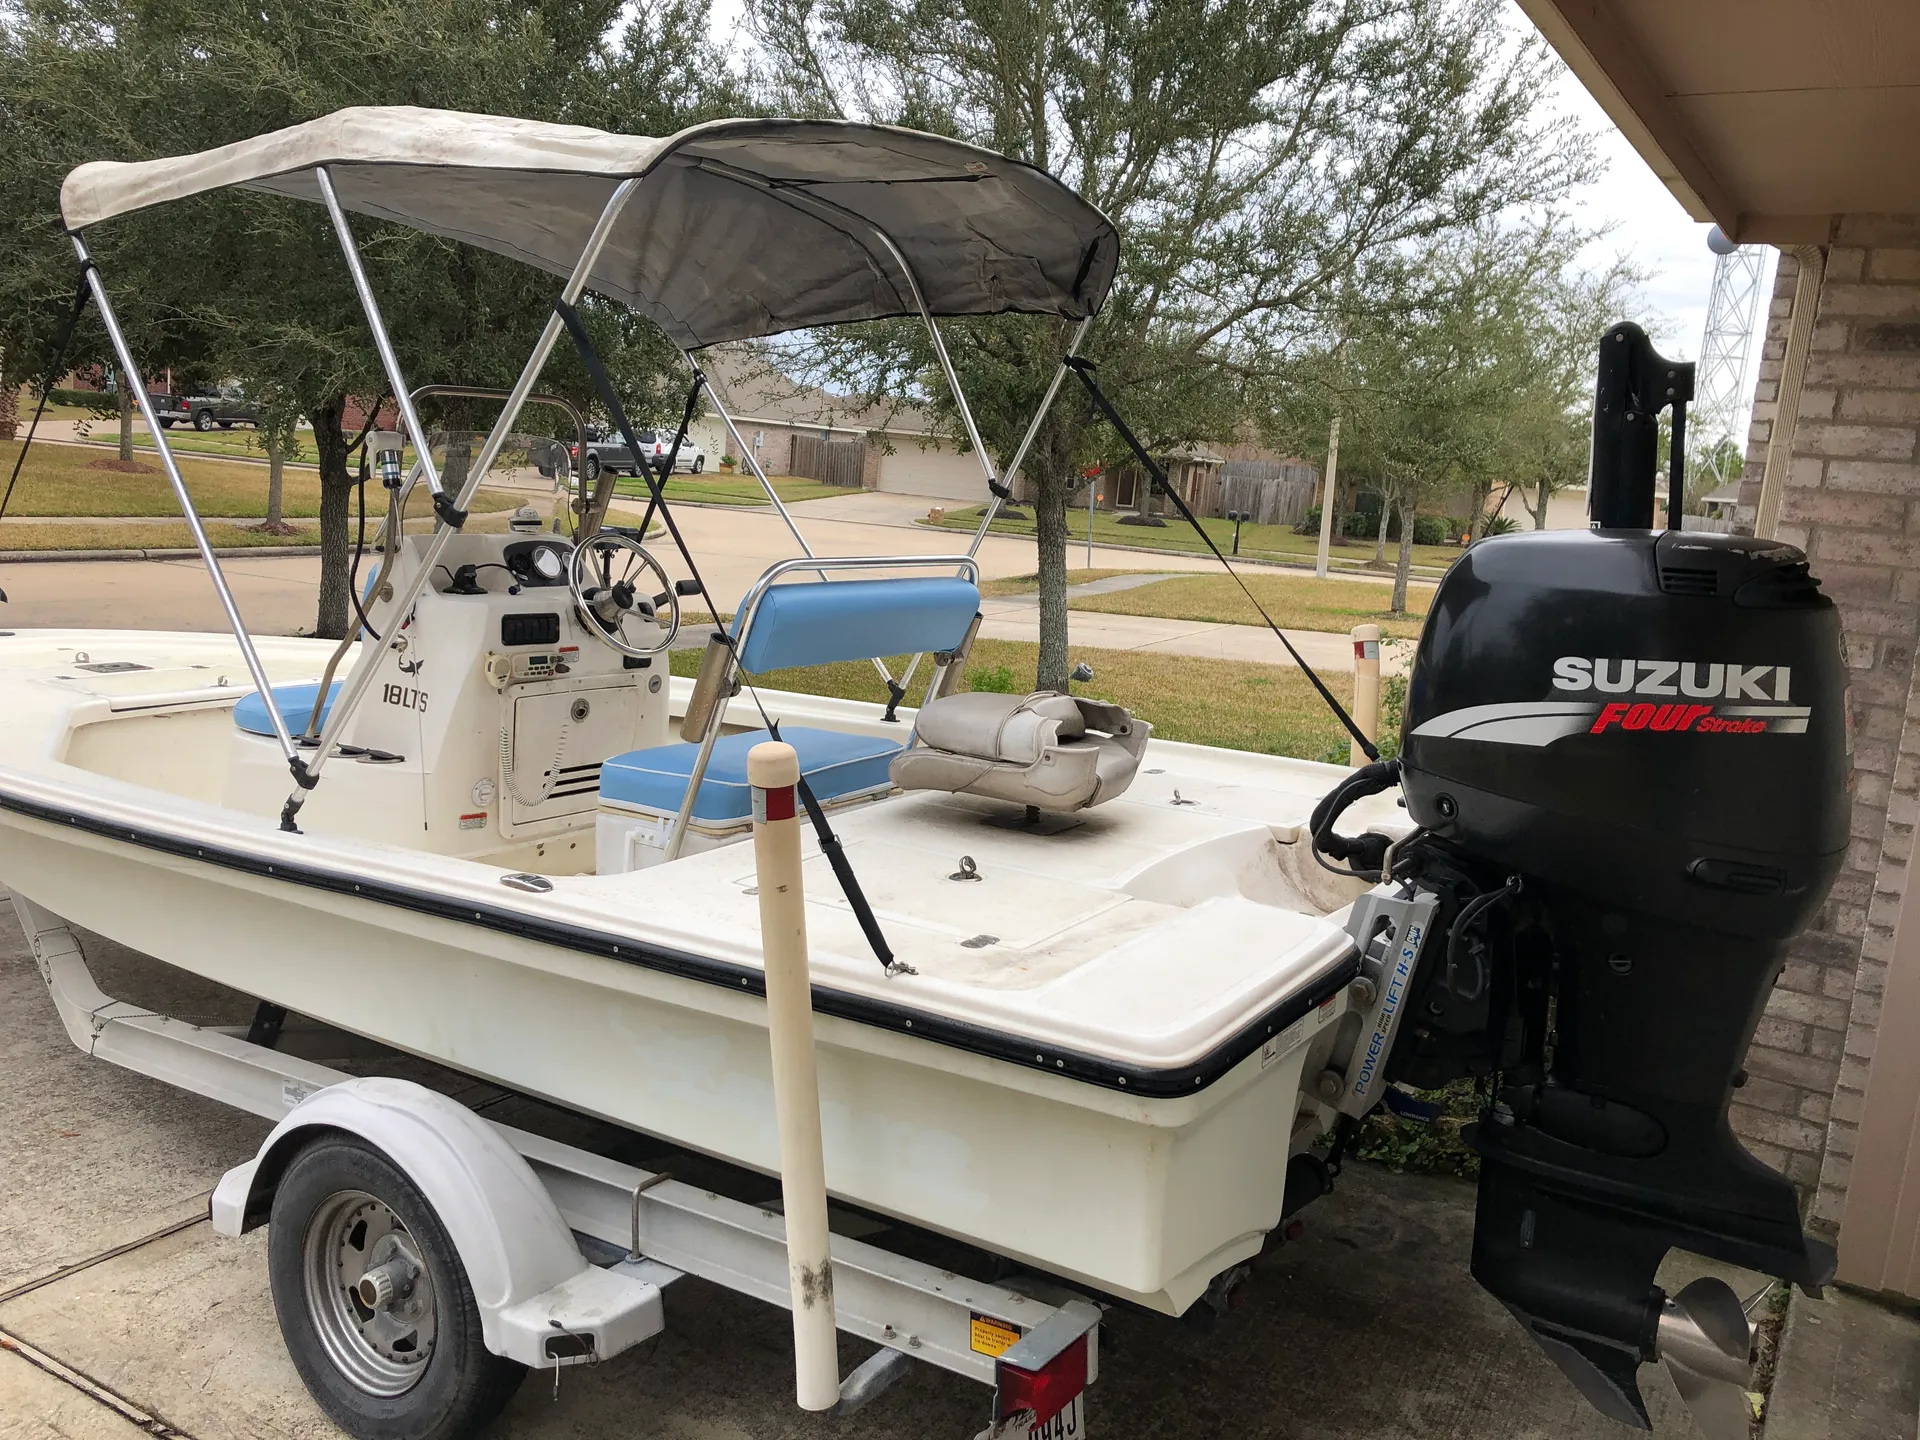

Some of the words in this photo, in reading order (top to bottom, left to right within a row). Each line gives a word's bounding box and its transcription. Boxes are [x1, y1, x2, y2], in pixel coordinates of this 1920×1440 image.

[1552, 656, 1791, 701] SUZUKI
[383, 683, 429, 713] 18LTS
[1696, 716, 1768, 734] Stroke
[1355, 1032, 1384, 1094] POWER
[1383, 976, 1403, 1014] LIFT
[1396, 947, 1414, 977] H-S
[1378, 1013, 1386, 1028] HIGH
[1382, 1014, 1391, 1033] SPEED
[985, 1317, 1012, 1331] WARNING
